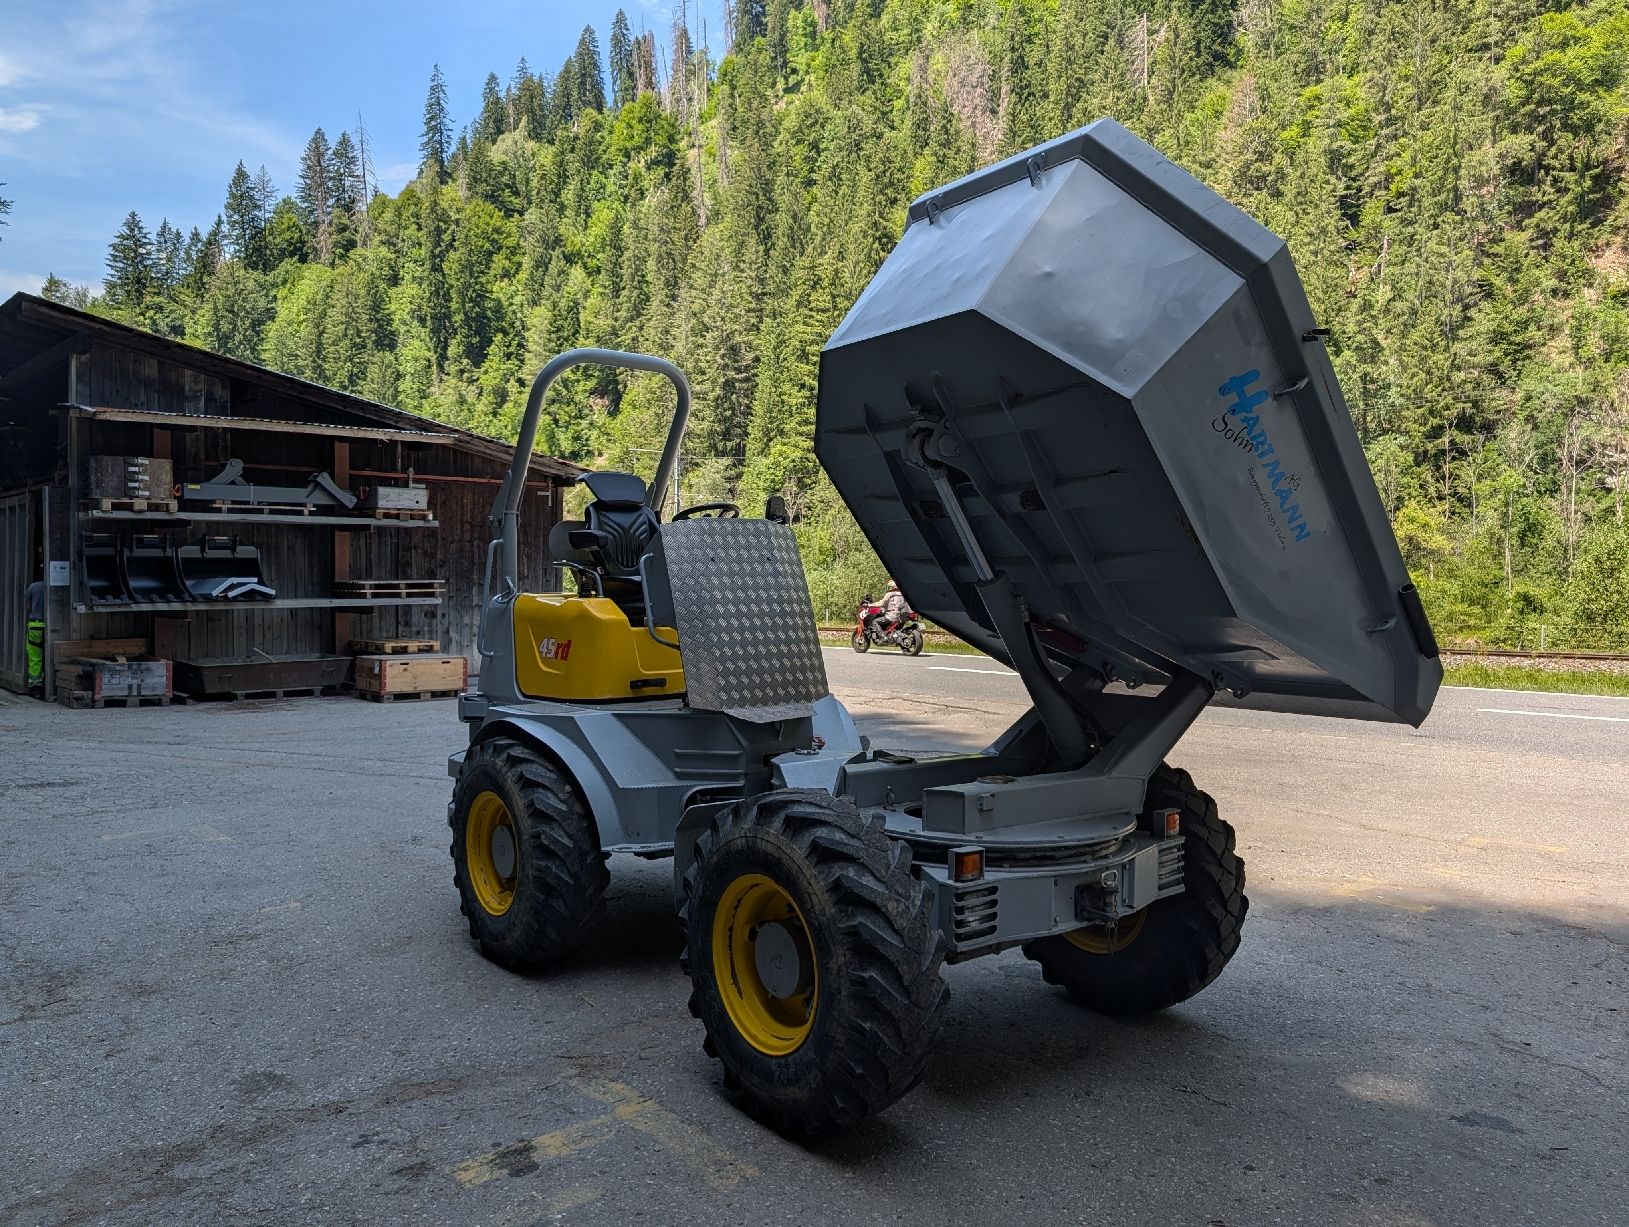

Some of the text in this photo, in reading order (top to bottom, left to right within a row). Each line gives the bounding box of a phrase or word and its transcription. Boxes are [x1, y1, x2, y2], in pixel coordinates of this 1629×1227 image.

[1212, 408, 1255, 453] Sohn
[1218, 369, 1311, 542] HARTMANN
[1285, 472, 1302, 491] AG
[540, 637, 573, 661] 45rd
